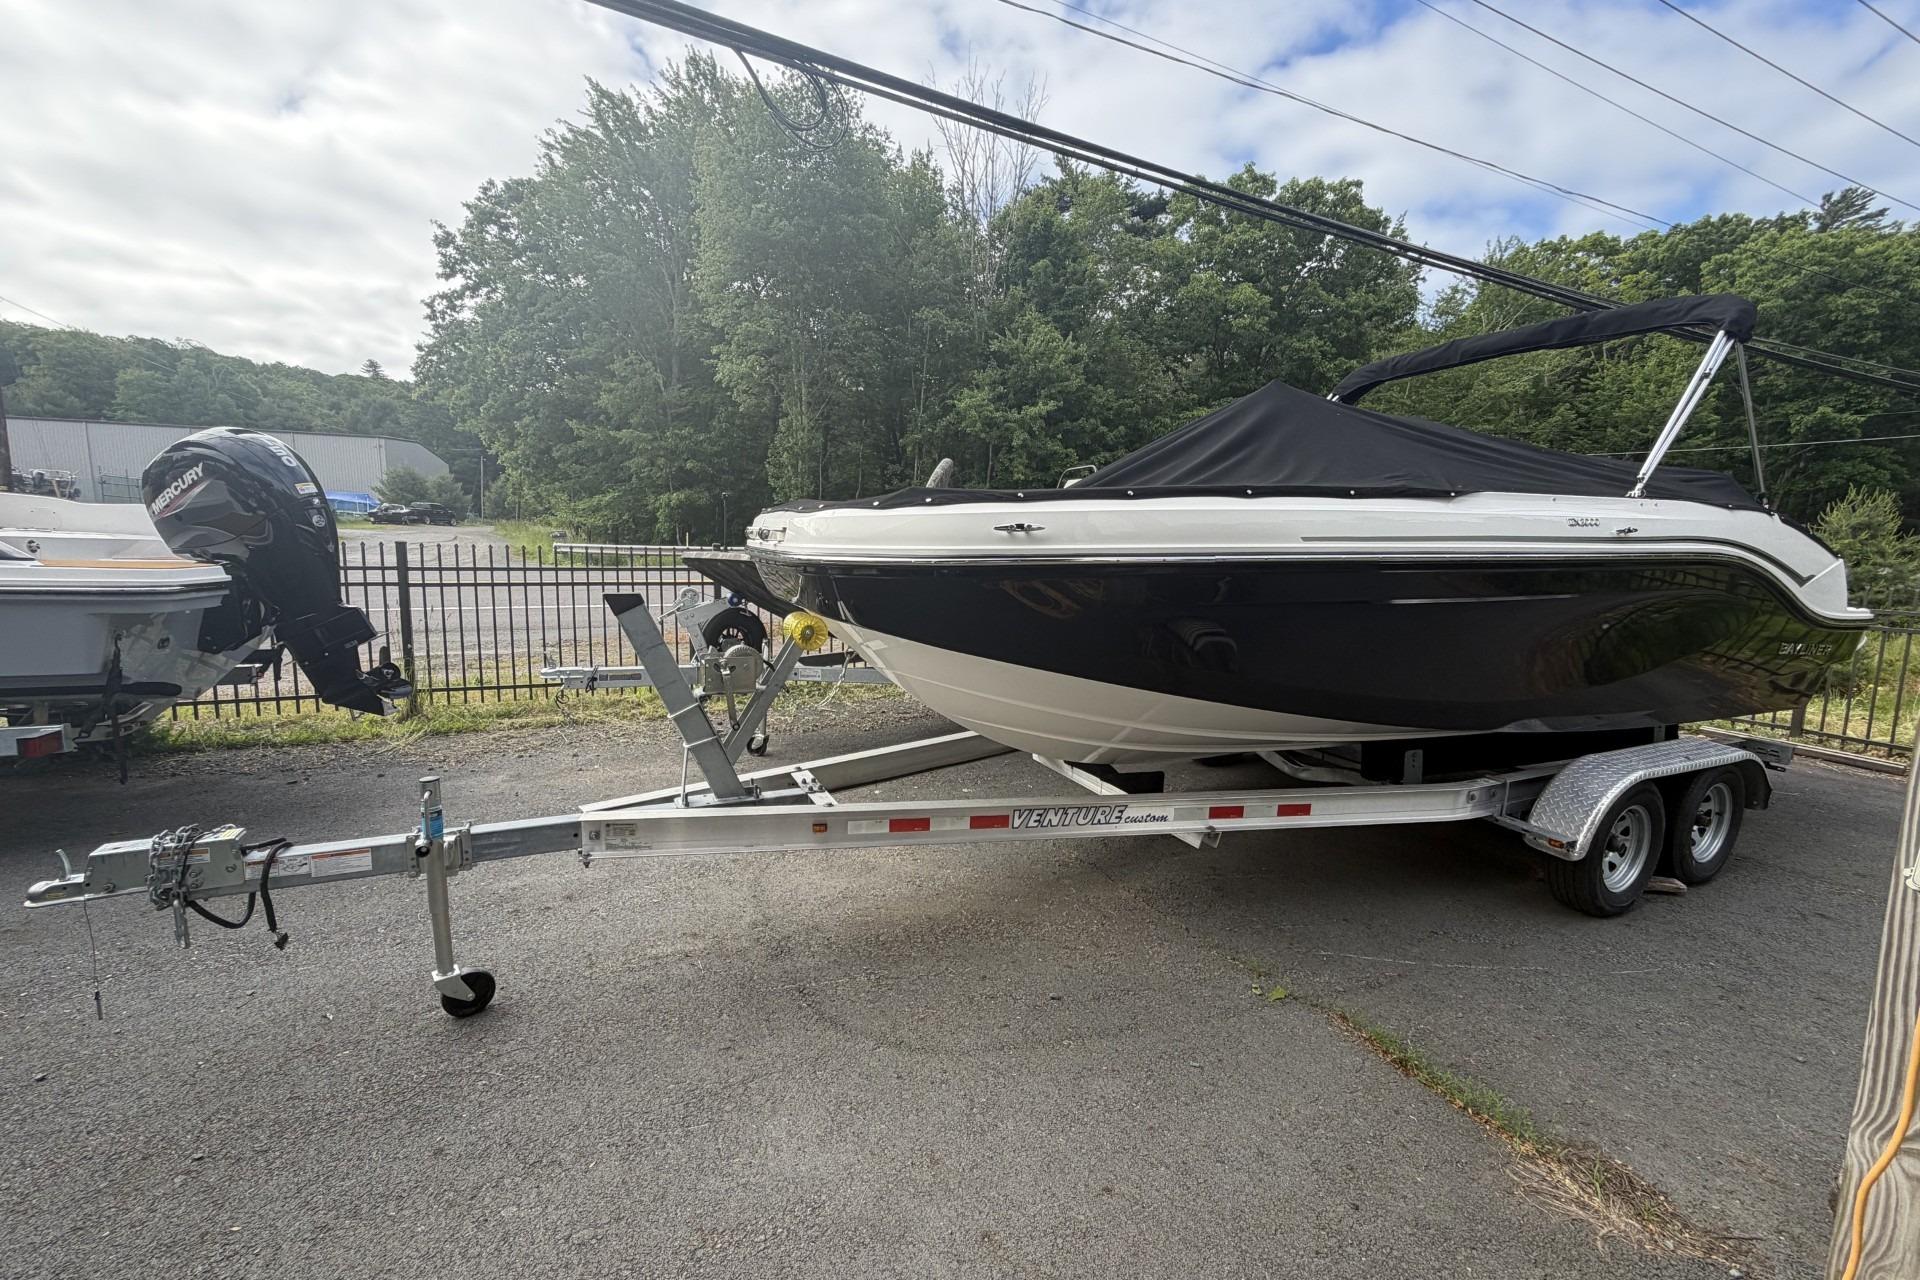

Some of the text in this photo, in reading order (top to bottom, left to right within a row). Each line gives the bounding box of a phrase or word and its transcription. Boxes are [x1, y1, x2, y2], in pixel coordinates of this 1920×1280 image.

[151, 462, 204, 515] MERCURY
[1779, 642, 1832, 655] BAYLINER
[1012, 804, 1169, 829] VENTURE custom
